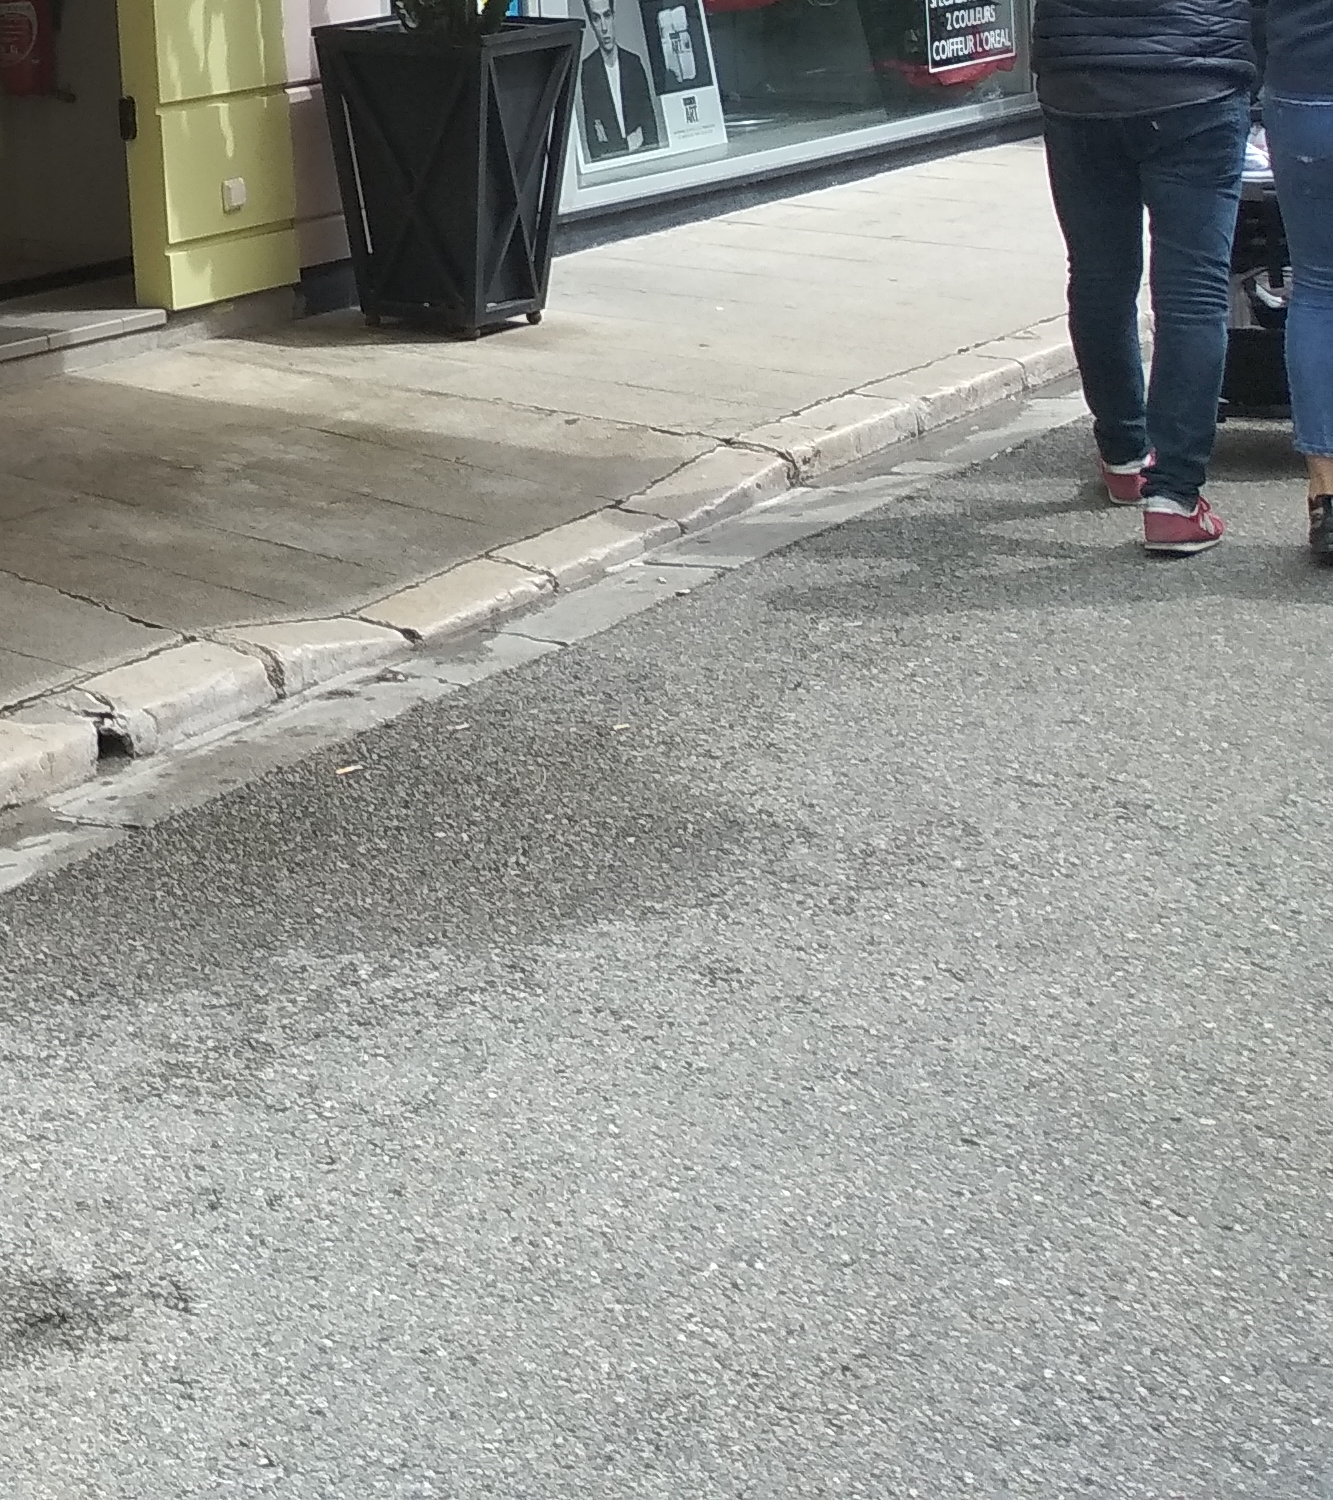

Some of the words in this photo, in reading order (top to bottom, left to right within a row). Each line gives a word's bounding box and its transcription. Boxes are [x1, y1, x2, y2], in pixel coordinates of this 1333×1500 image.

[945, 12, 953, 31] 2
[953, 4, 996, 29] COULEURS
[932, 34, 976, 61] COIFFEUR
[976, 28, 1012, 53] L'OREAL
